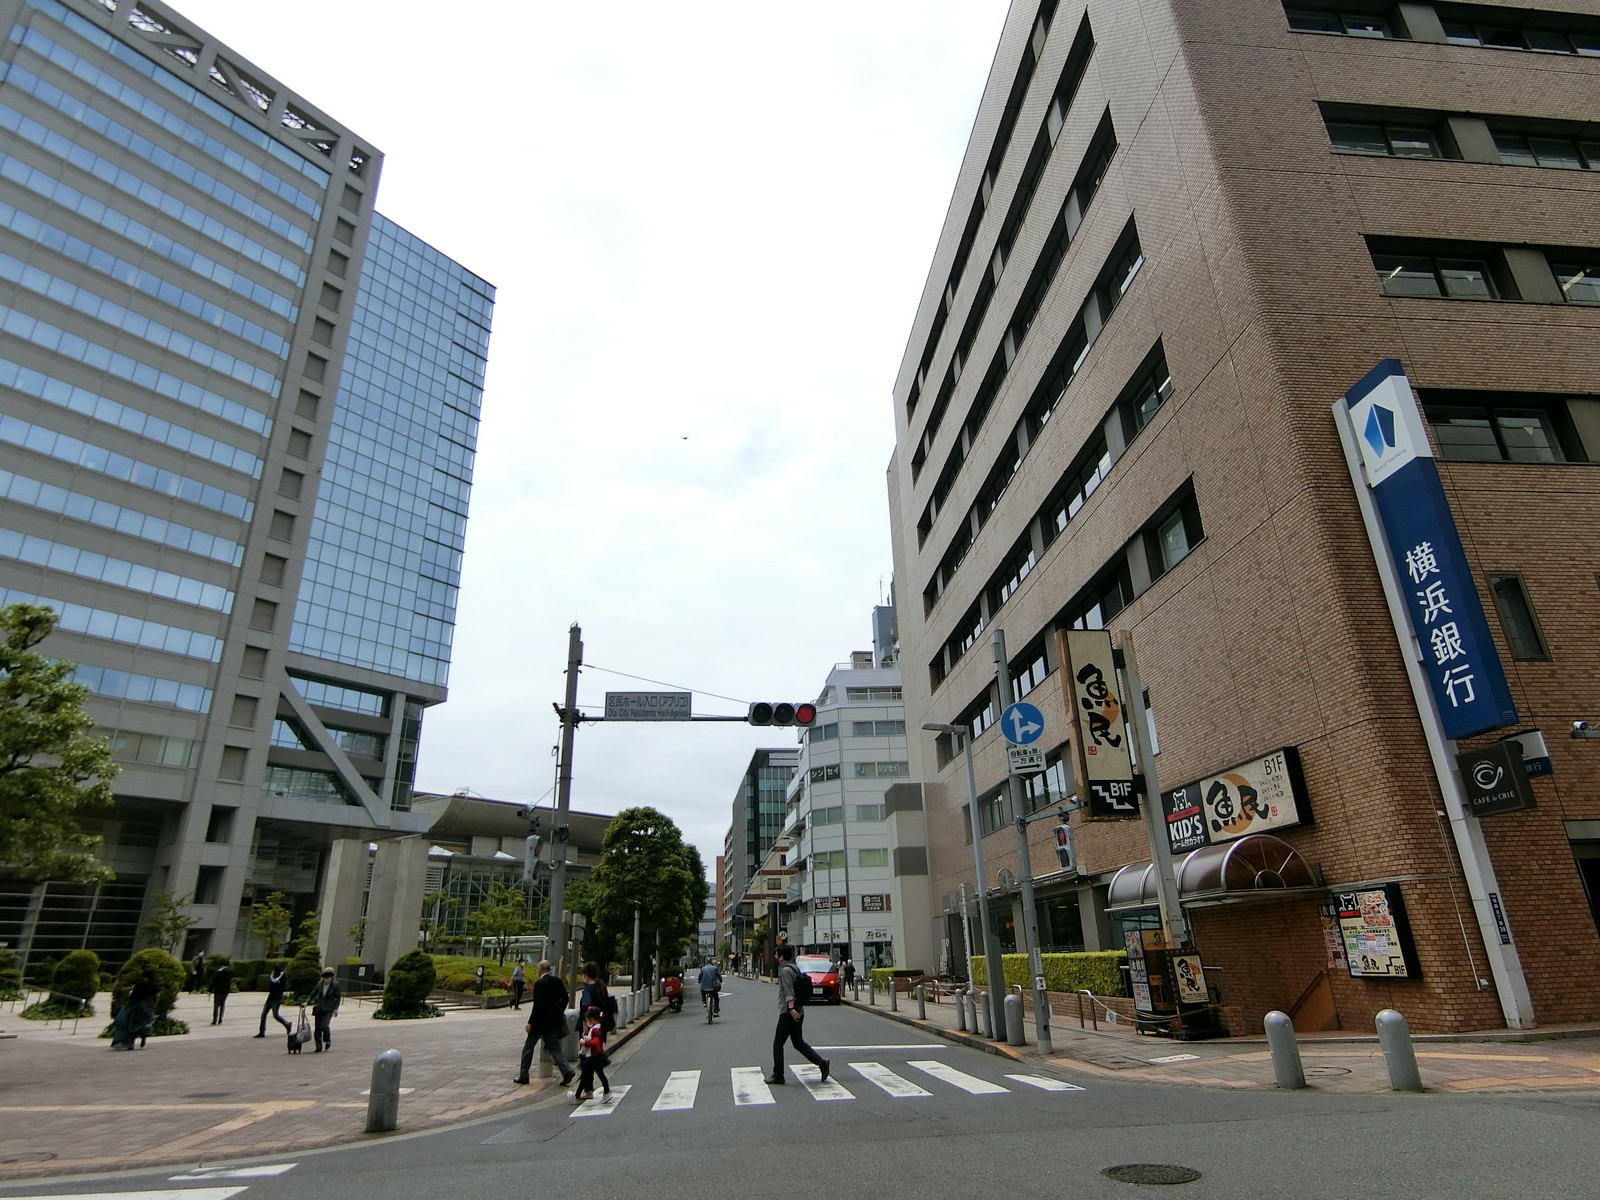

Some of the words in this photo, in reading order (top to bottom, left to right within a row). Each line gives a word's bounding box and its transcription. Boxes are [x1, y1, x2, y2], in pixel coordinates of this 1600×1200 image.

[1405, 541, 1476, 708] 横浜銀行
[607, 708, 617, 718] Ota
[618, 708, 629, 719] City
[1012, 755, 1043, 765] 一方通行
[1263, 754, 1283, 776] B1F
[1109, 782, 1132, 797] B1F
[1169, 815, 1203, 841] KID'S
